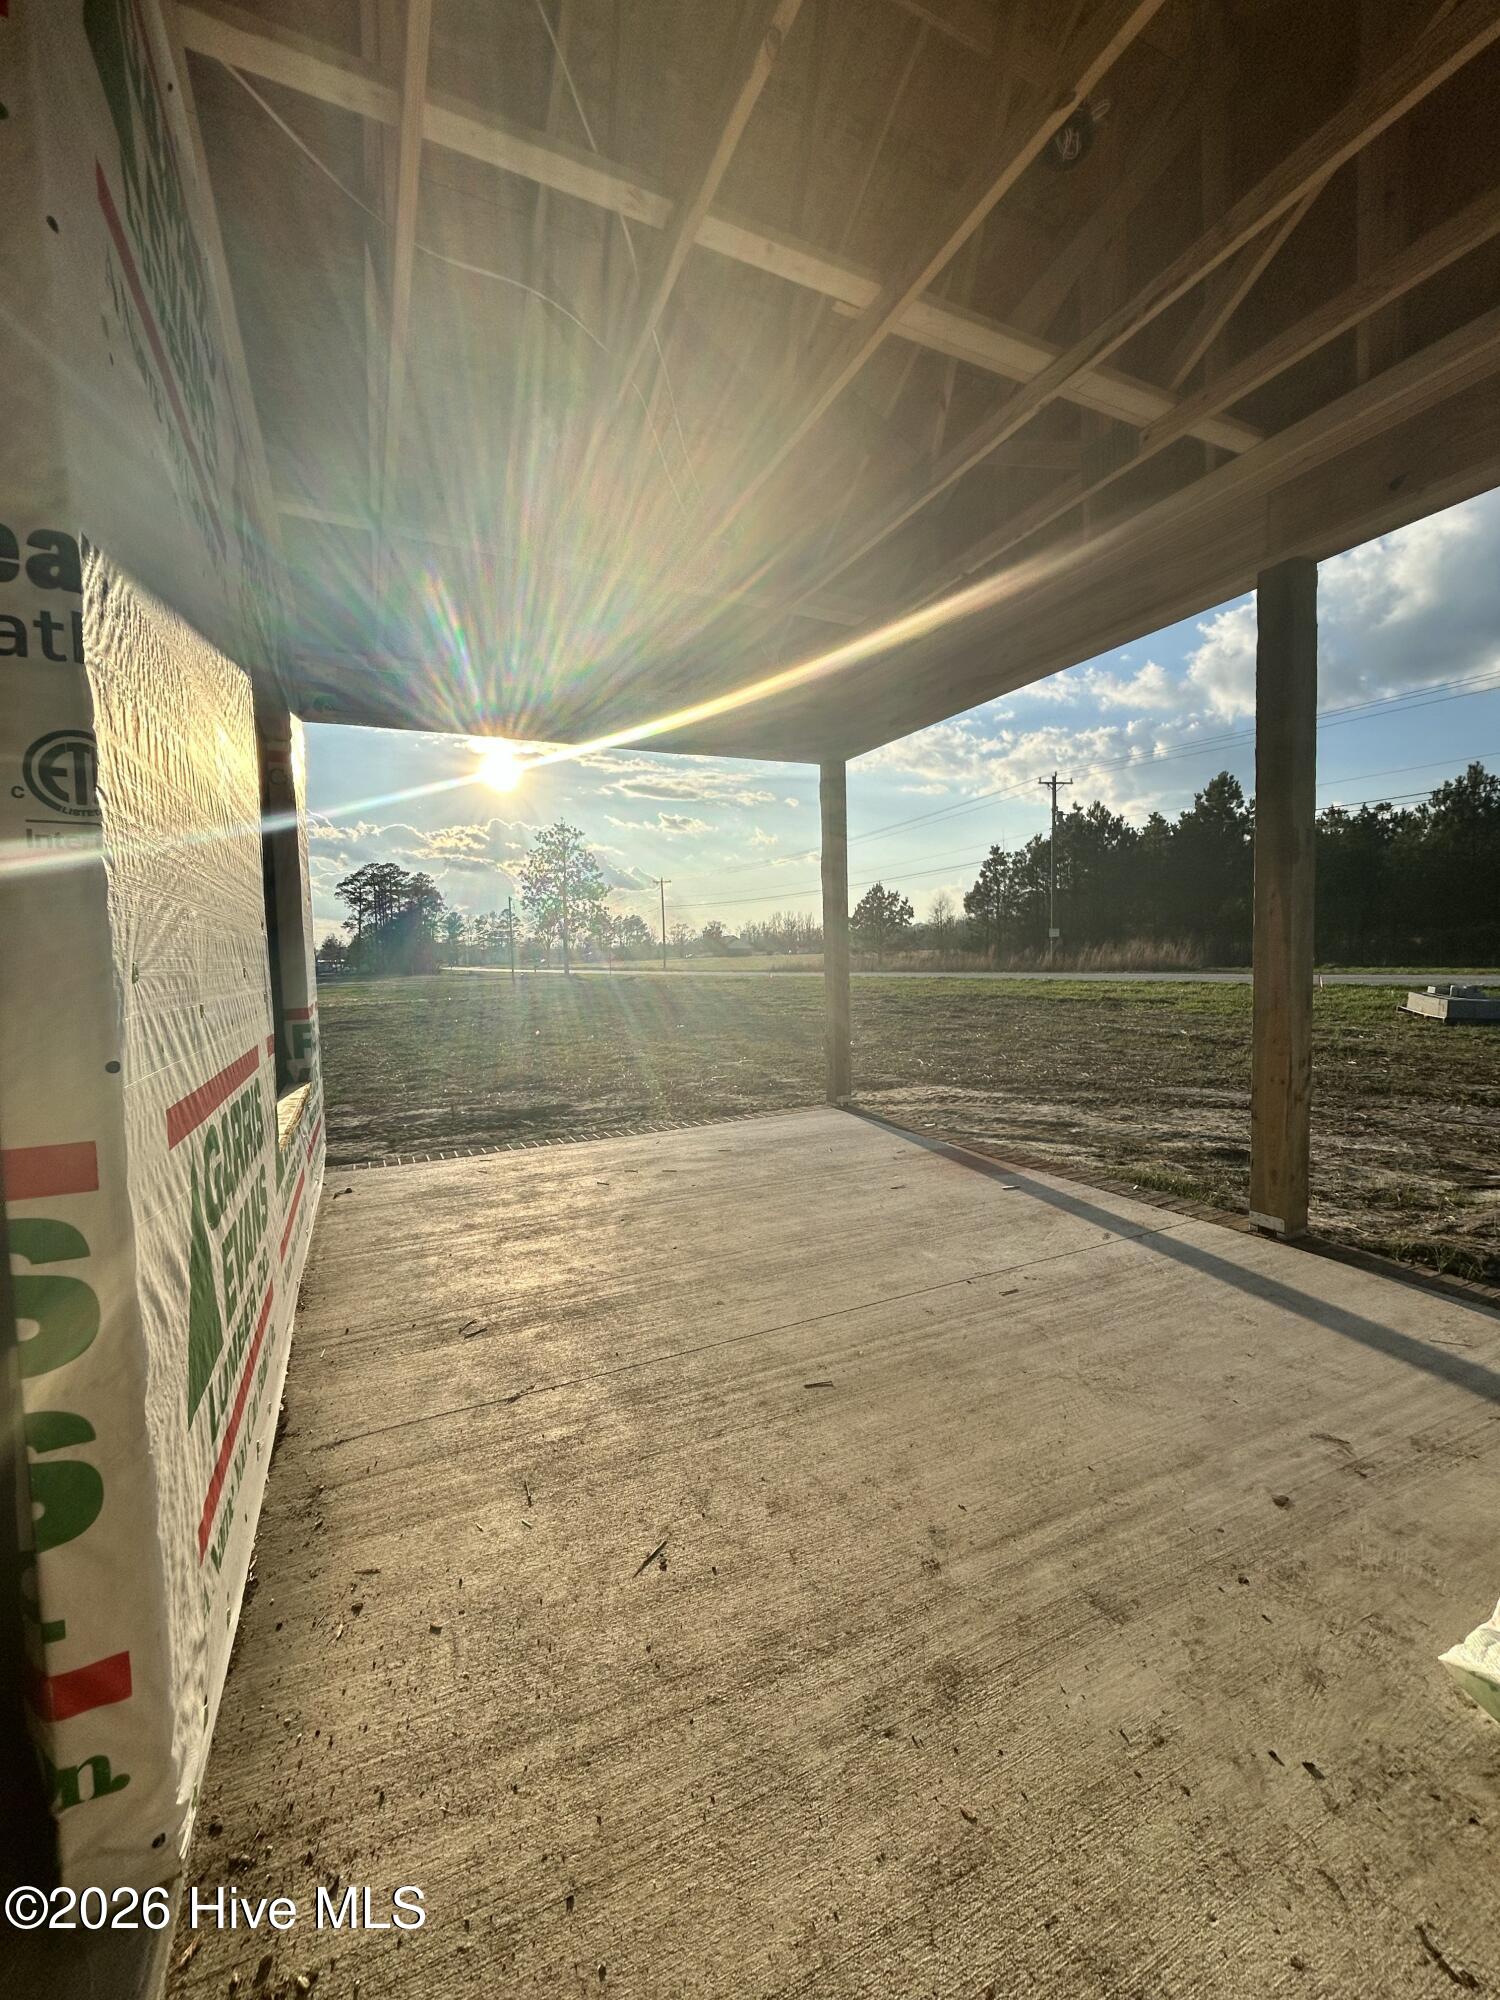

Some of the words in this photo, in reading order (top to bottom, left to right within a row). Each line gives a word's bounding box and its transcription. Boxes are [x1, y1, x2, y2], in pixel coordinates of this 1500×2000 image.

[203, 1077, 264, 1231] GARRIS
[222, 1163, 268, 1324] EVANS
[208, 1268, 257, 1447] LUMBER
